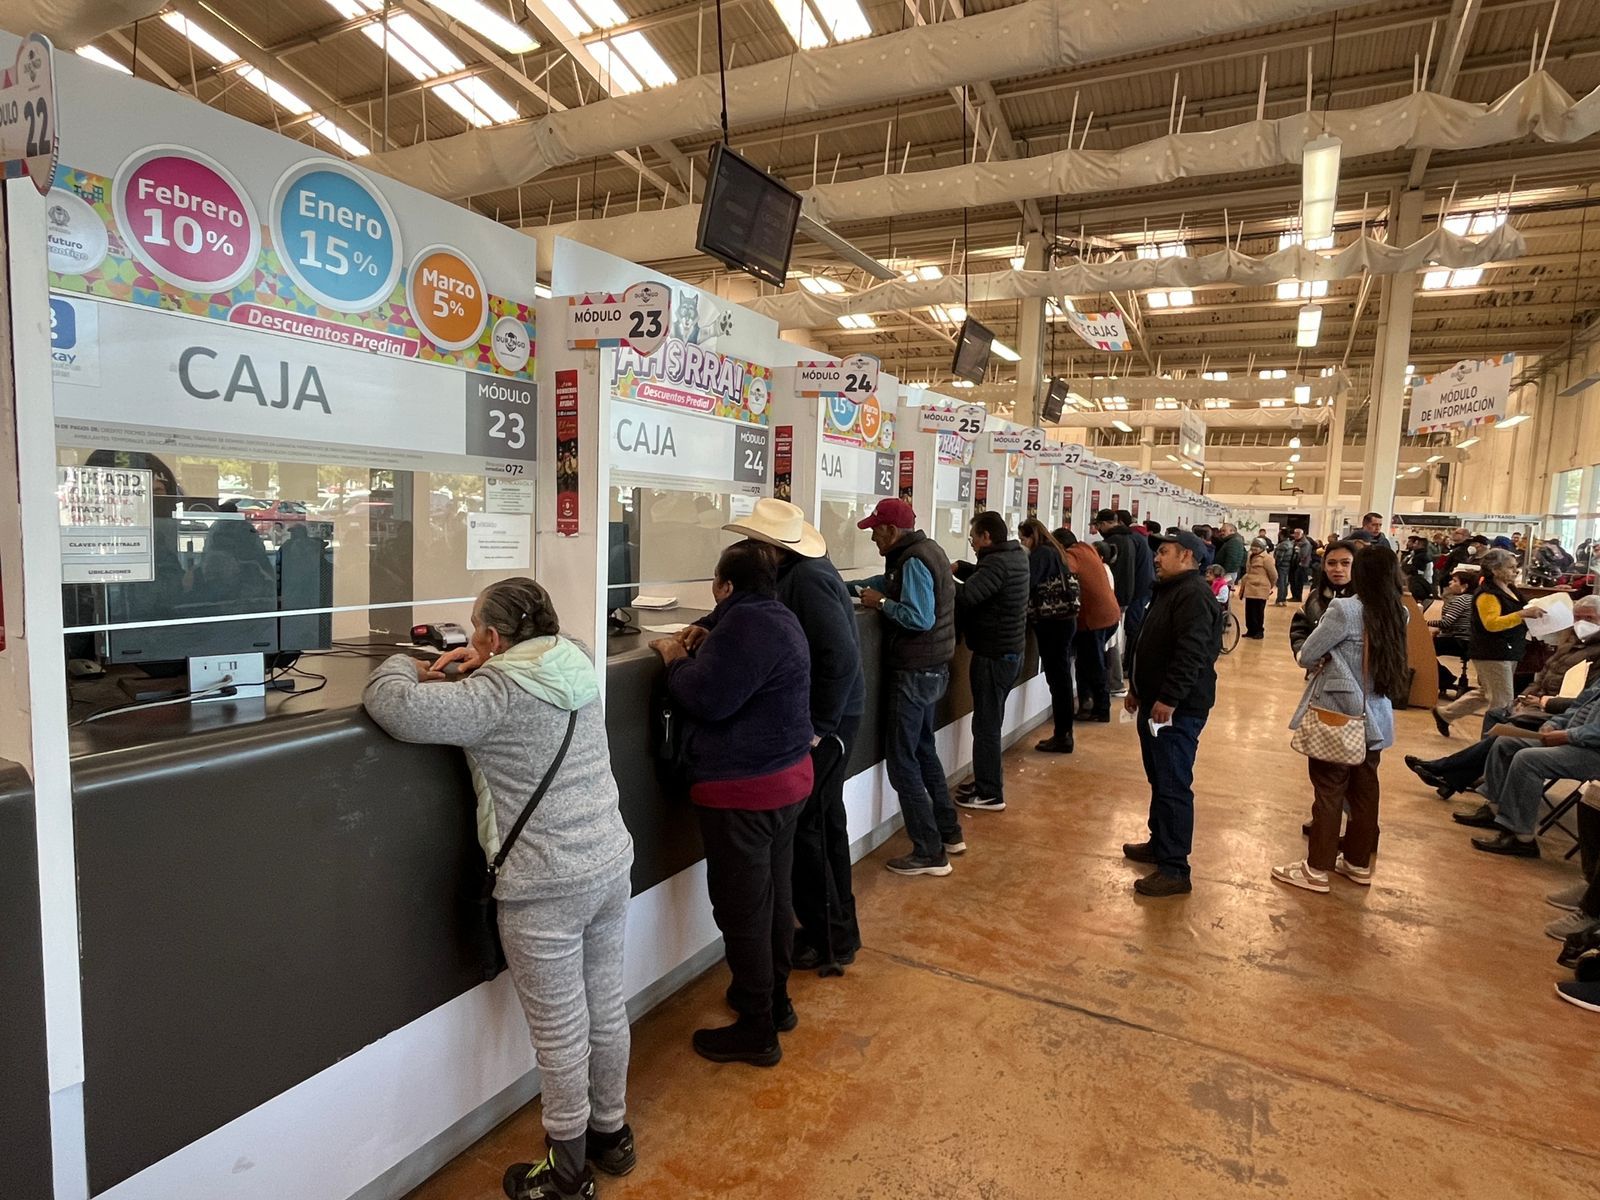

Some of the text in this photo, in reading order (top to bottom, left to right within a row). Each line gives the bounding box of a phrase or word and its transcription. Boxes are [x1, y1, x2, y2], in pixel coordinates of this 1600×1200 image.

[24, 97, 50, 157] 22
[138, 178, 243, 228] Febrero
[299, 190, 382, 240] Enero
[143, 208, 234, 256] 10%
[299, 230, 378, 276] 15%
[423, 268, 475, 300] Marzo
[433, 292, 465, 317] 5%
[574, 309, 622, 323] MÓDULO
[628, 310, 662, 338] 23
[248, 308, 406, 358] Descuentos Predial
[1086, 325, 1119, 337] CAJAS
[178, 346, 332, 414] CAJA
[802, 369, 840, 380] MÓDULO
[844, 373, 872, 392] 24
[478, 382, 531, 405] MÓDULO
[643, 387, 710, 409] Descuentos Predial
[1440, 386, 1478, 404] MÓDULO
[924, 412, 955, 423] MÓDULO
[1421, 396, 1495, 421] DE INFORMACIÓN
[489, 410, 526, 449] 23
[959, 418, 980, 434] 25
[616, 419, 677, 457] CAJA
[740, 432, 765, 446] MÓDULO
[994, 436, 1020, 444] MÓDULO
[1023, 439, 1041, 451] 26
[744, 450, 764, 477] 24
[821, 453, 842, 478] AJA
[1065, 454, 1079, 463] 27
[505, 464, 524, 476] 072
[880, 470, 892, 490] 25
[1099, 469, 1113, 479] 28
[1119, 473, 1131, 481] 29
